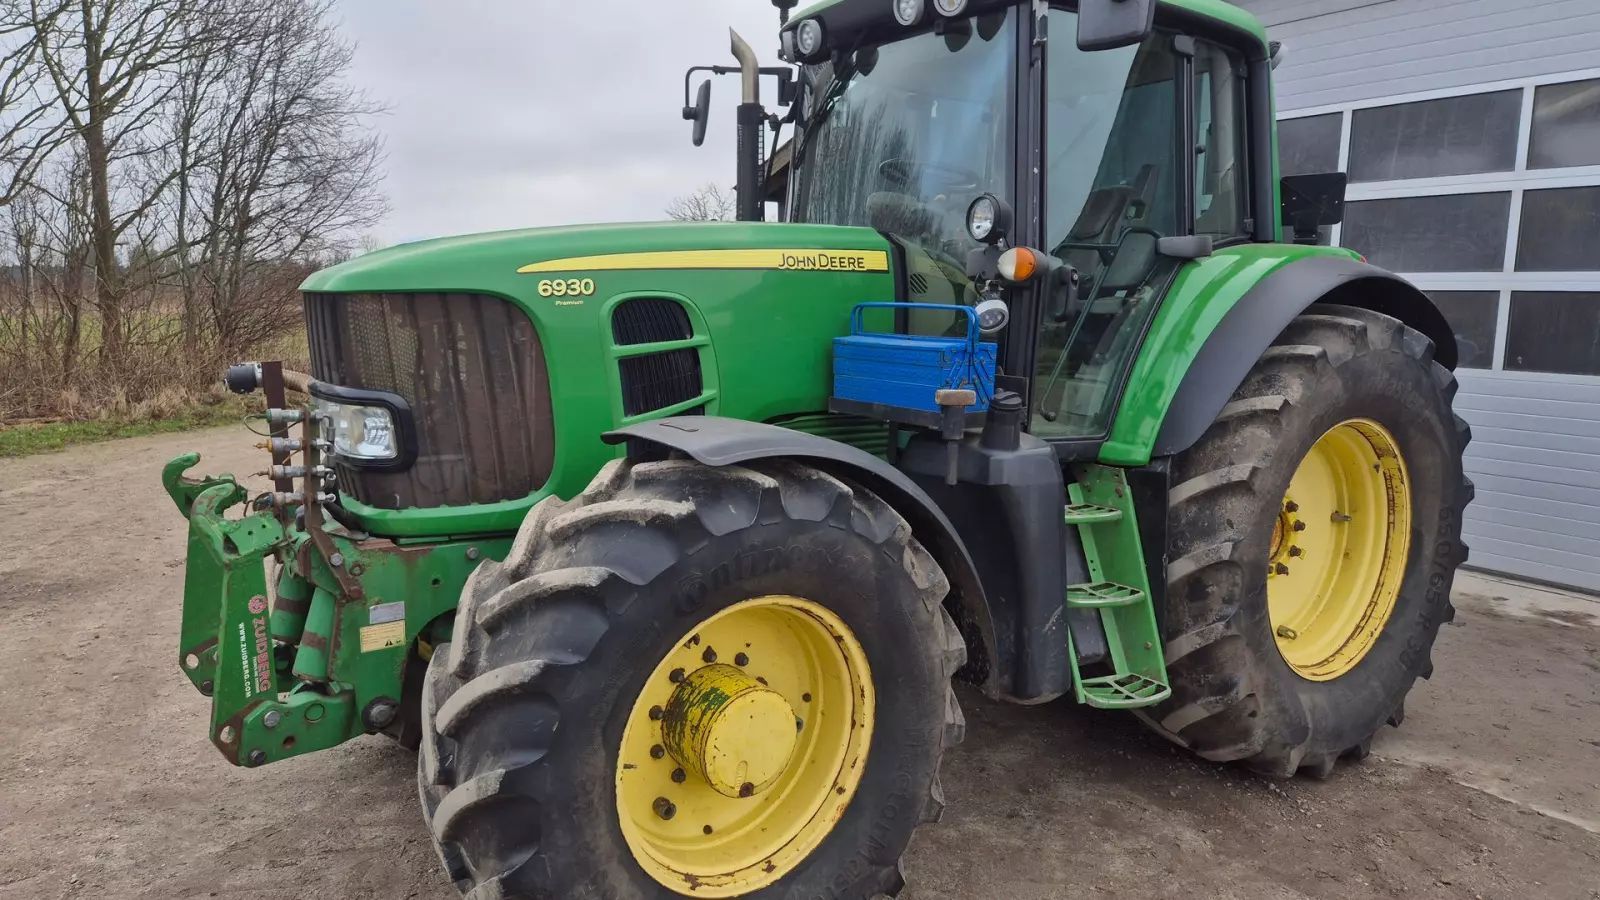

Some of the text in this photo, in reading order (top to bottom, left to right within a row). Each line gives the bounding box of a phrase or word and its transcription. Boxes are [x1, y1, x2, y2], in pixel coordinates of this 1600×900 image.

[778, 252, 865, 269] JOHN DEERE
[537, 278, 595, 297] 6930
[238, 622, 252, 698] WWW.ZUIDBERG.COM
[252, 616, 272, 692] ZUIDBERG
